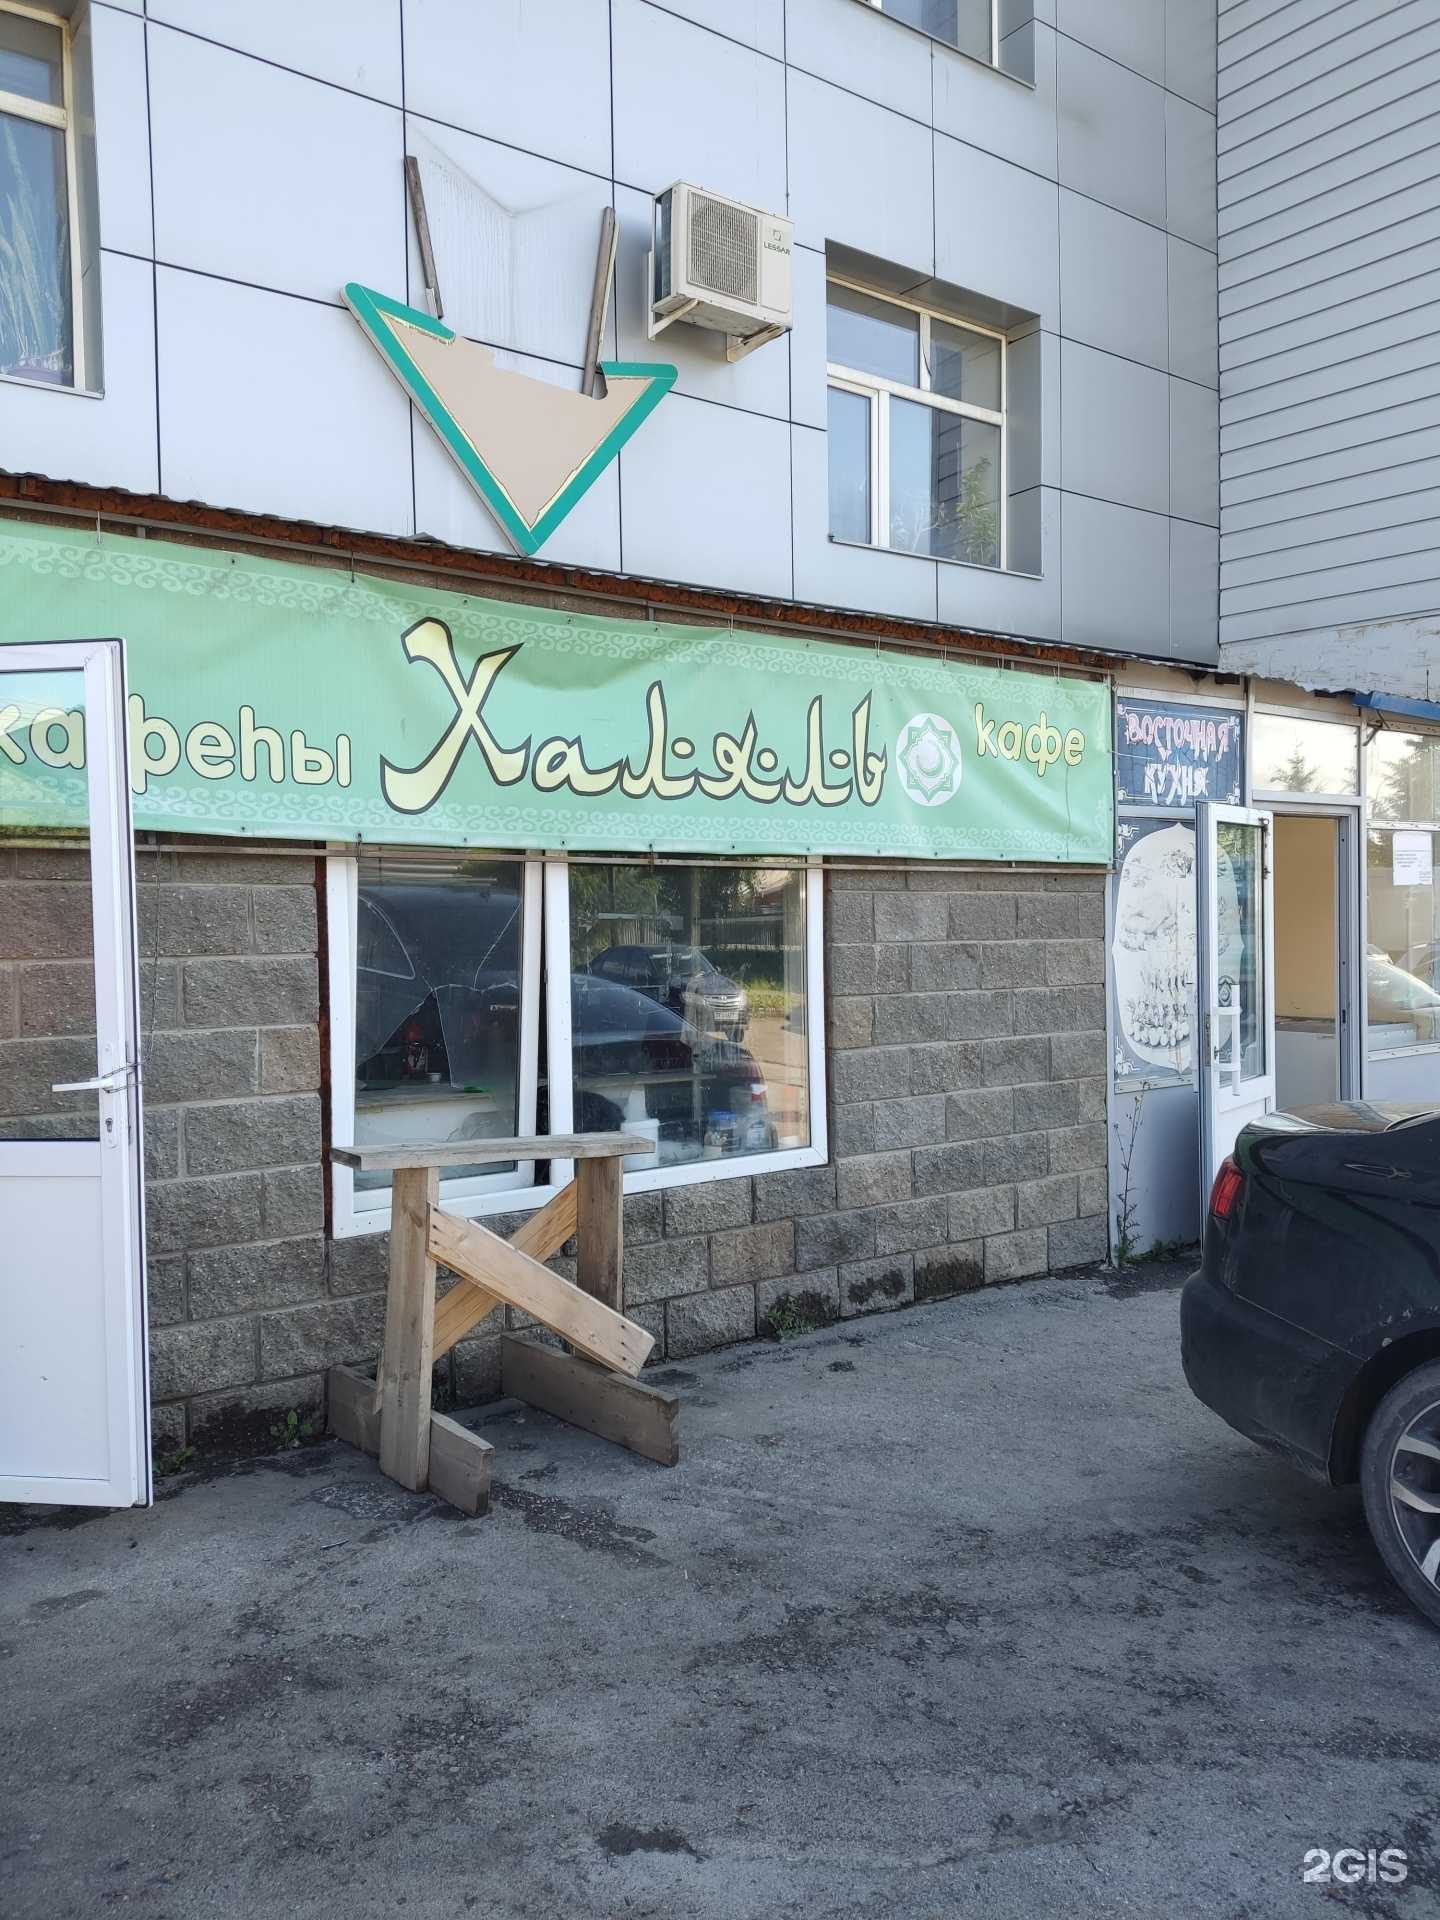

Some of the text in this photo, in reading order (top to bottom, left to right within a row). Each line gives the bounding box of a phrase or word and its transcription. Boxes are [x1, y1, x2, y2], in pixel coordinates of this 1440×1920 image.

[763, 241, 791, 256] LESSAR
[975, 703, 1086, 777] кафе
[1125, 713, 1229, 762] ВОСТОЧНАЯ
[1144, 763, 1208, 806] КУХНЯ
